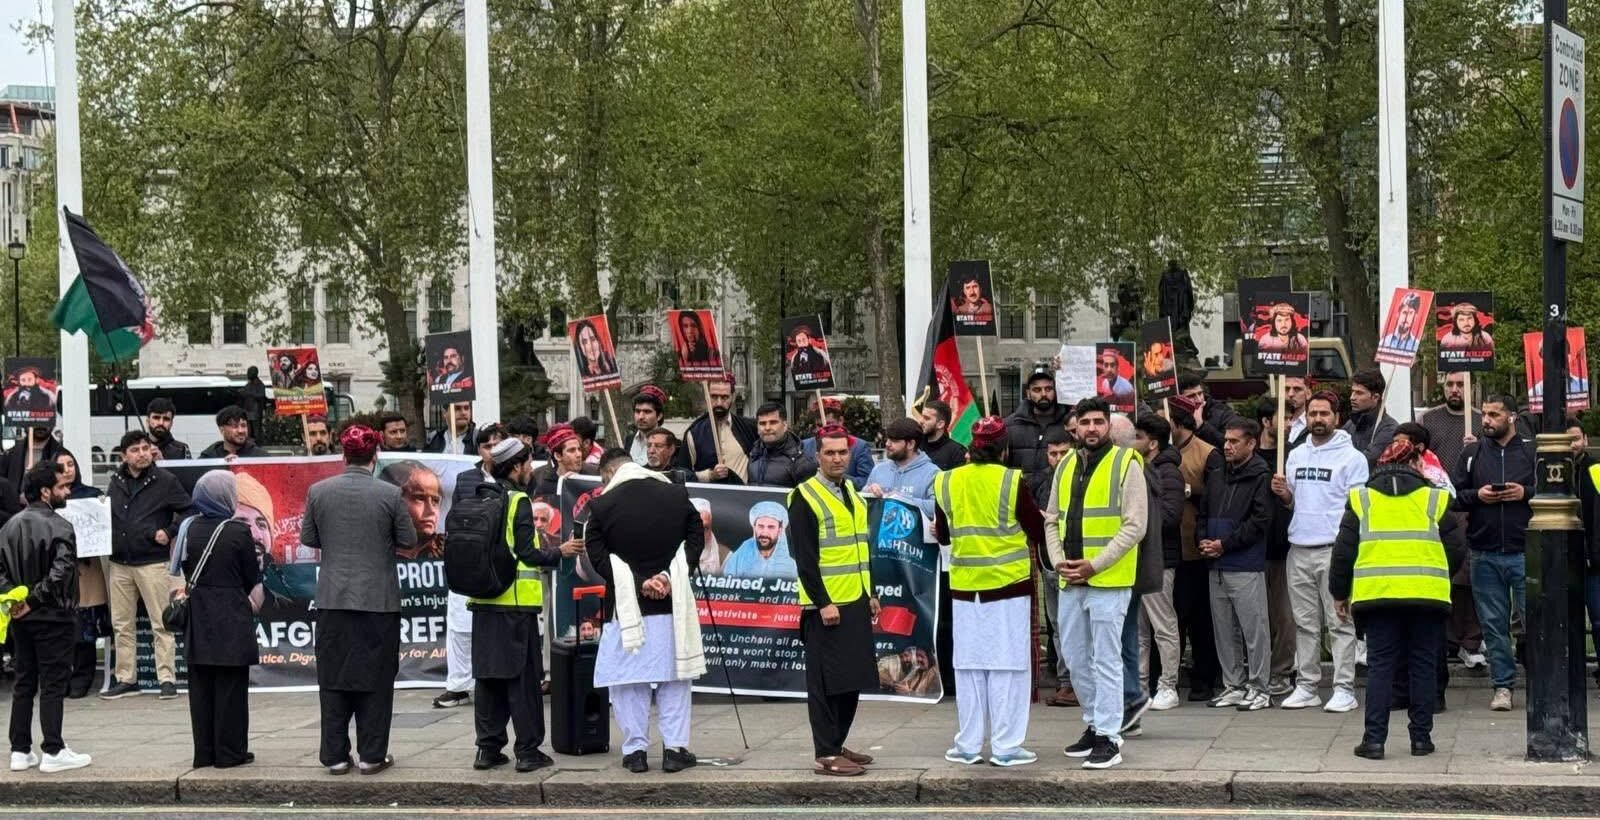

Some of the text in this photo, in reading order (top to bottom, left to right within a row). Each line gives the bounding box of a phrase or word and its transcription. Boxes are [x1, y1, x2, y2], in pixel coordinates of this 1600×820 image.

[1556, 33, 1583, 64] Controlled
[1560, 63, 1578, 92] ZONE
[1550, 304, 1559, 316] 3
[1257, 352, 1281, 360] STATE
[695, 574, 766, 593] chained,
[710, 593, 741, 603] speak
[759, 595, 779, 604] and
[730, 633, 773, 645] Unchain
[776, 636, 790, 646] all
[409, 648, 428, 658] for
[743, 648, 772, 657] won't
[775, 650, 798, 660] stop
[725, 658, 747, 670] only
[750, 660, 778, 669] make
[781, 661, 789, 670] it
